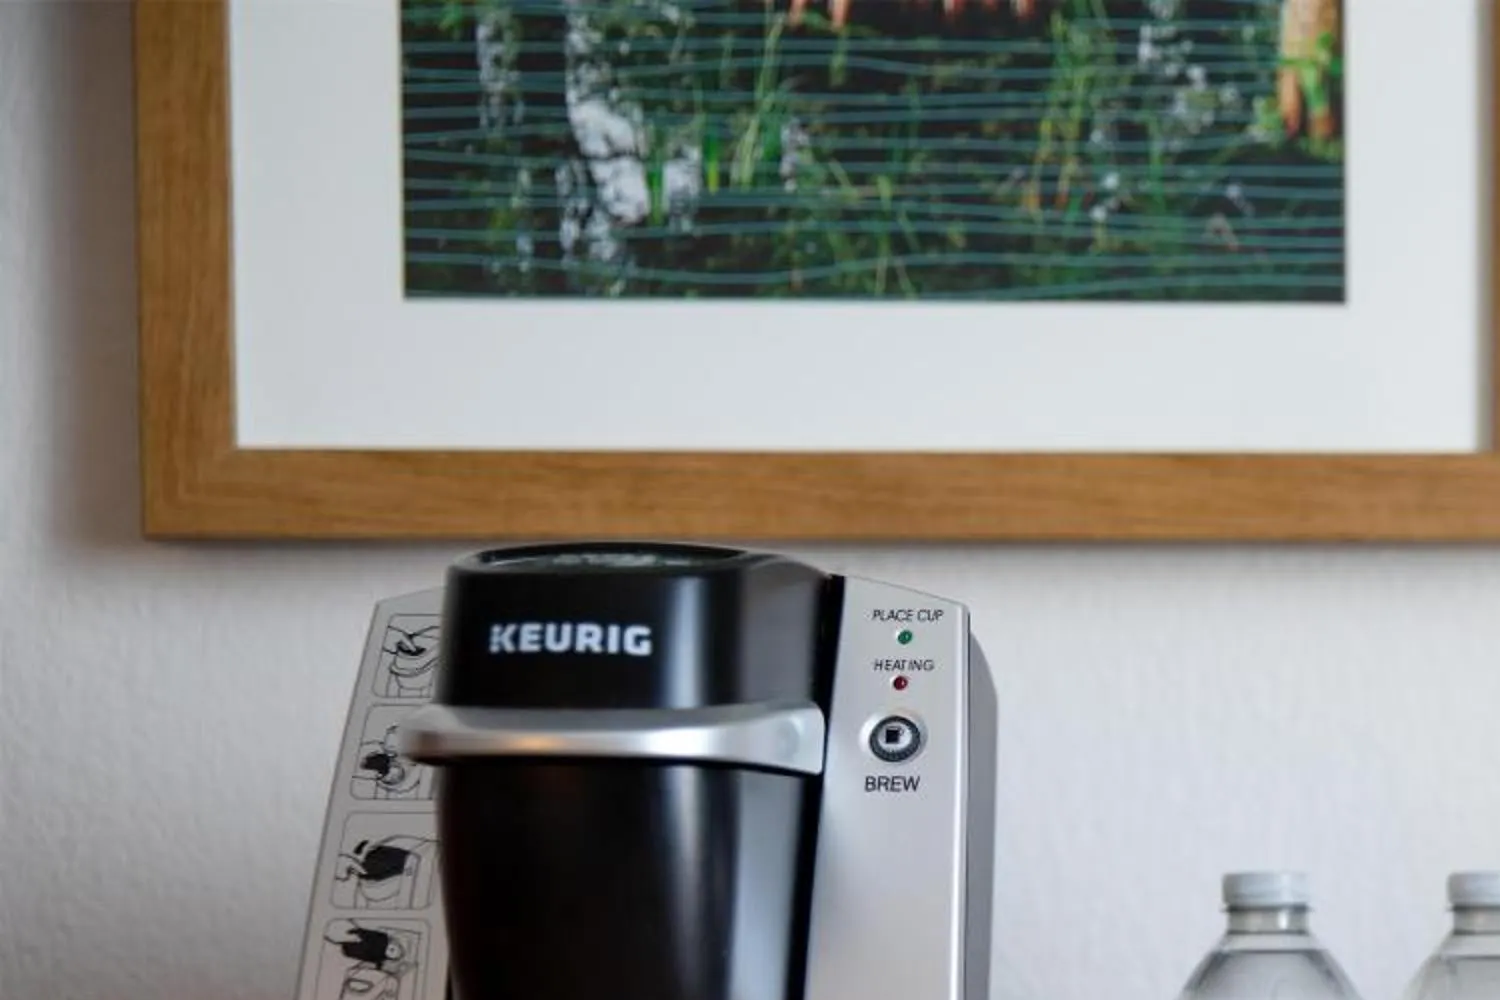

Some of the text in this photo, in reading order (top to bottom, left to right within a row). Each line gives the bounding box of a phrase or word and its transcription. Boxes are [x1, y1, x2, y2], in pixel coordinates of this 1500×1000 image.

[872, 608, 944, 622] PLACE CUP
[490, 622, 653, 656] KEURIG
[873, 659, 935, 672] HEATING
[864, 775, 921, 793] BREW
